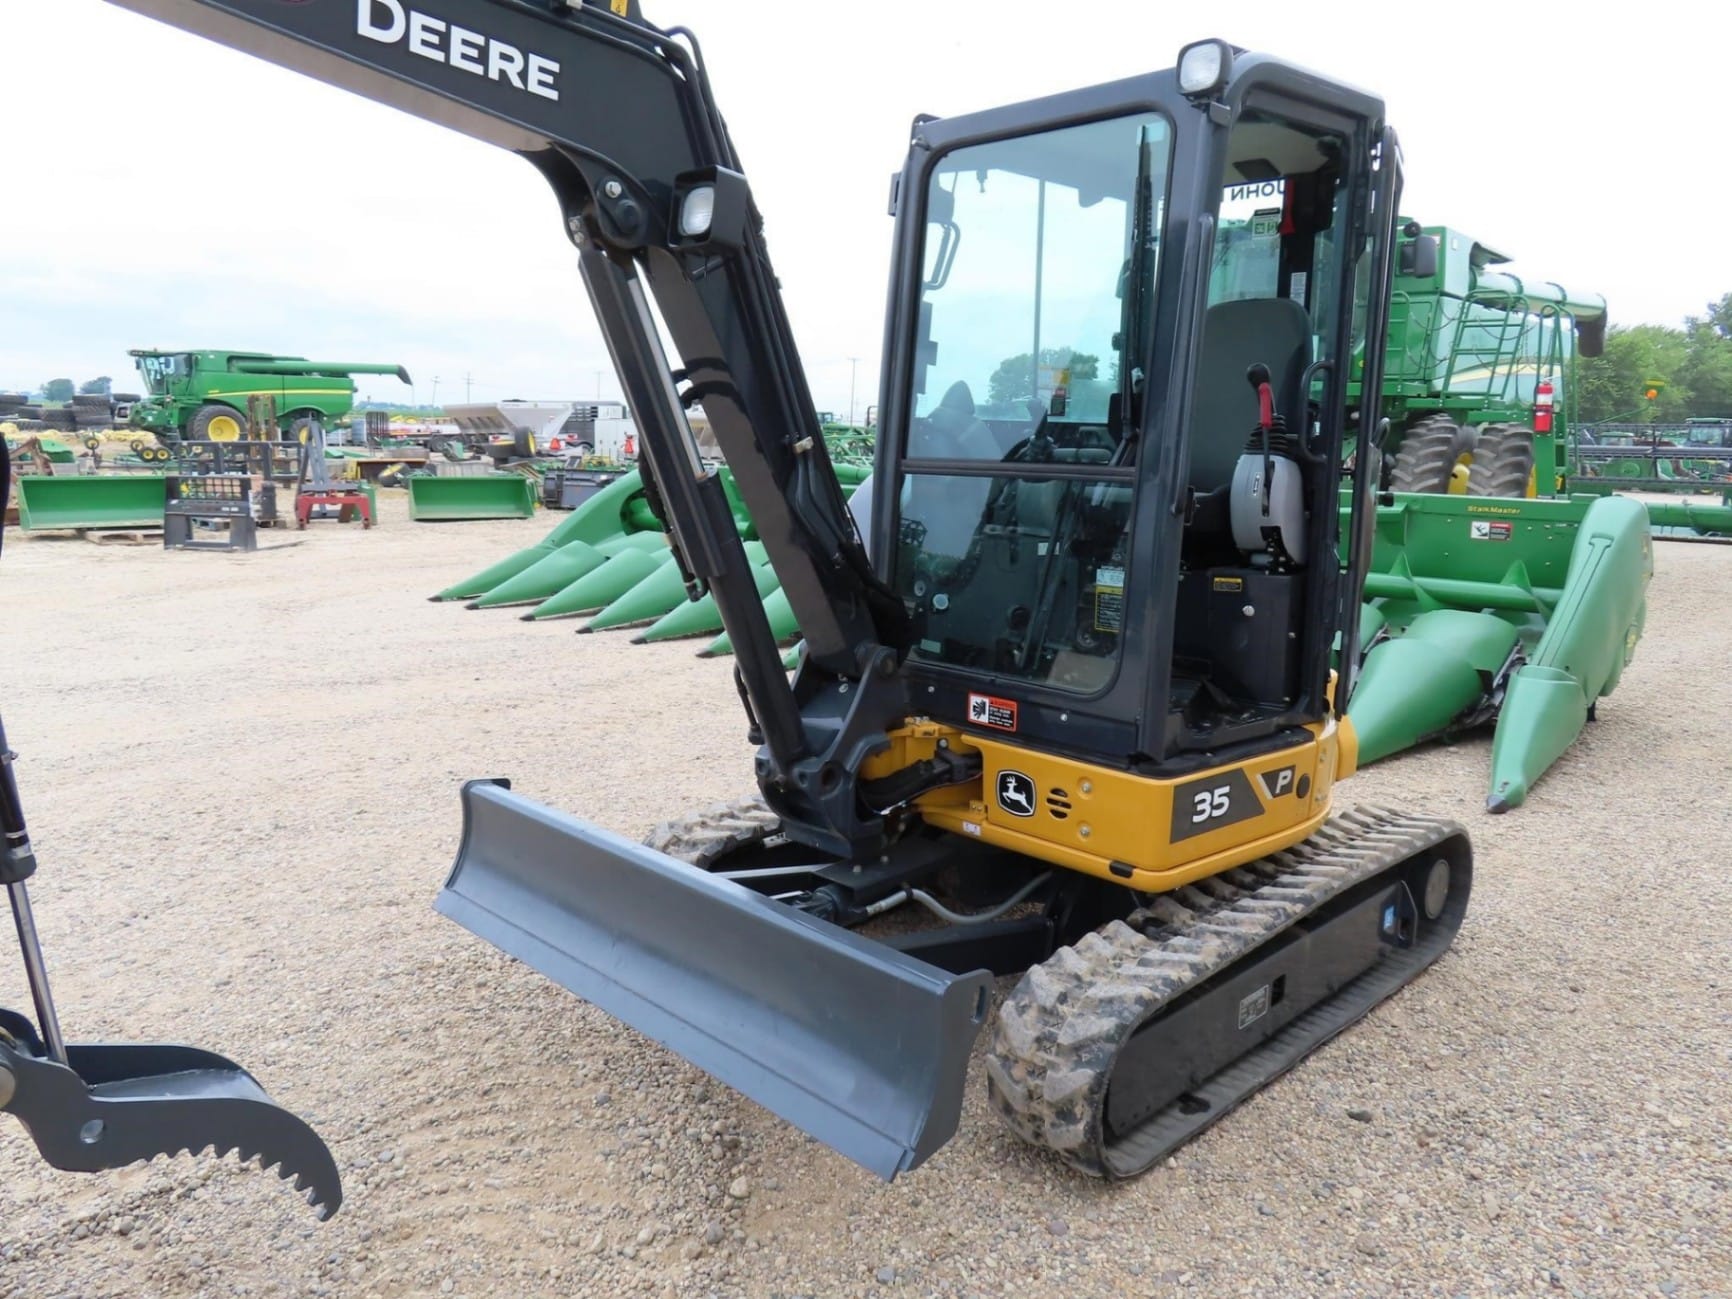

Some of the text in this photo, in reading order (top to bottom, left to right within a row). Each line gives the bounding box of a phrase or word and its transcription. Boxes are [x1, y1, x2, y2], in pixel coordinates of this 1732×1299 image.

[357, 0, 560, 101] DEERE
[1192, 769, 1293, 823] 35 P
